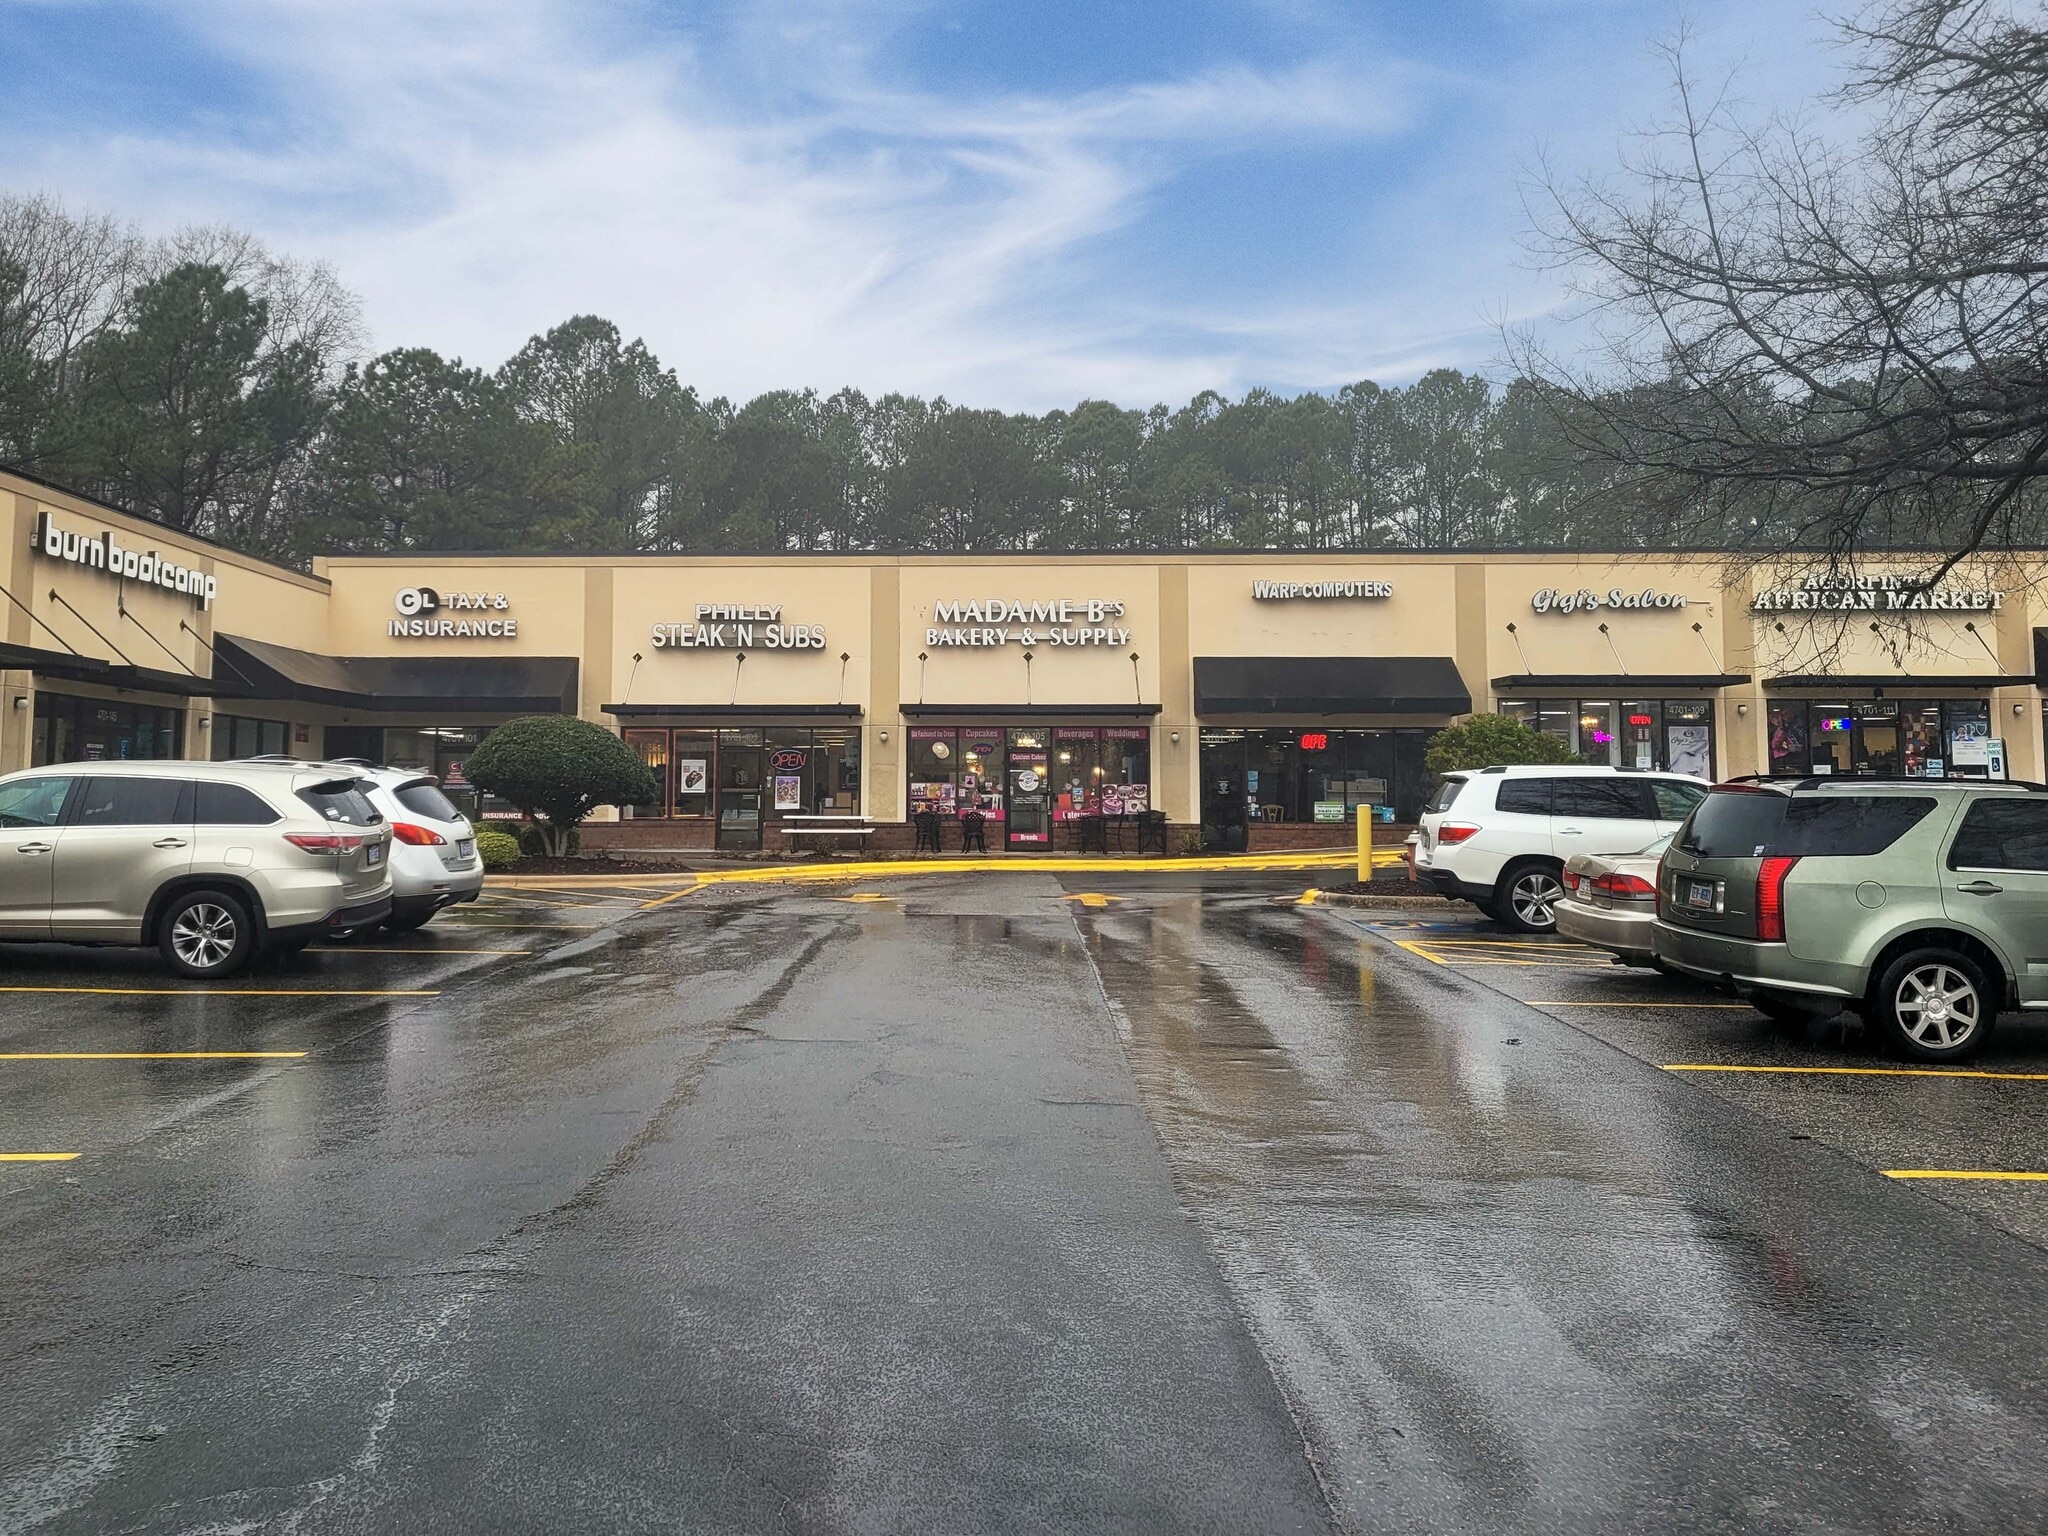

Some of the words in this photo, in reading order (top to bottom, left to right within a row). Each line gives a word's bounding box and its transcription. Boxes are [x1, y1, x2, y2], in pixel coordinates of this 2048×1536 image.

[39, 512, 104, 569] burn
[102, 532, 216, 611] bootcamp
[1302, 581, 1393, 598] COMPUTERS
[445, 593, 488, 609] TAX
[493, 593, 509, 609] &
[1532, 588, 1599, 614] Gigi's
[1608, 588, 1687, 609] Salon
[1754, 591, 1876, 610] AFRICAN
[1886, 591, 2005, 610] MARKET
[695, 603, 783, 621] PHILLY
[934, 600, 1073, 623] MADAME
[387, 619, 518, 637] INSURANCE
[651, 623, 726, 648] STEAK
[764, 623, 827, 649] SUBS
[926, 628, 1009, 646] BAKERY
[1021, 627, 1038, 646] &
[1049, 627, 1131, 646] SUPPLY
[1630, 715, 1652, 725] OPEN
[1822, 719, 1850, 731] OPE
[965, 729, 998, 738] Cupcakes
[1058, 729, 1094, 738] Beverages
[1107, 729, 1140, 738] Weddings
[771, 753, 807, 767] OPEN
[482, 812, 523, 820] INSURANCE
